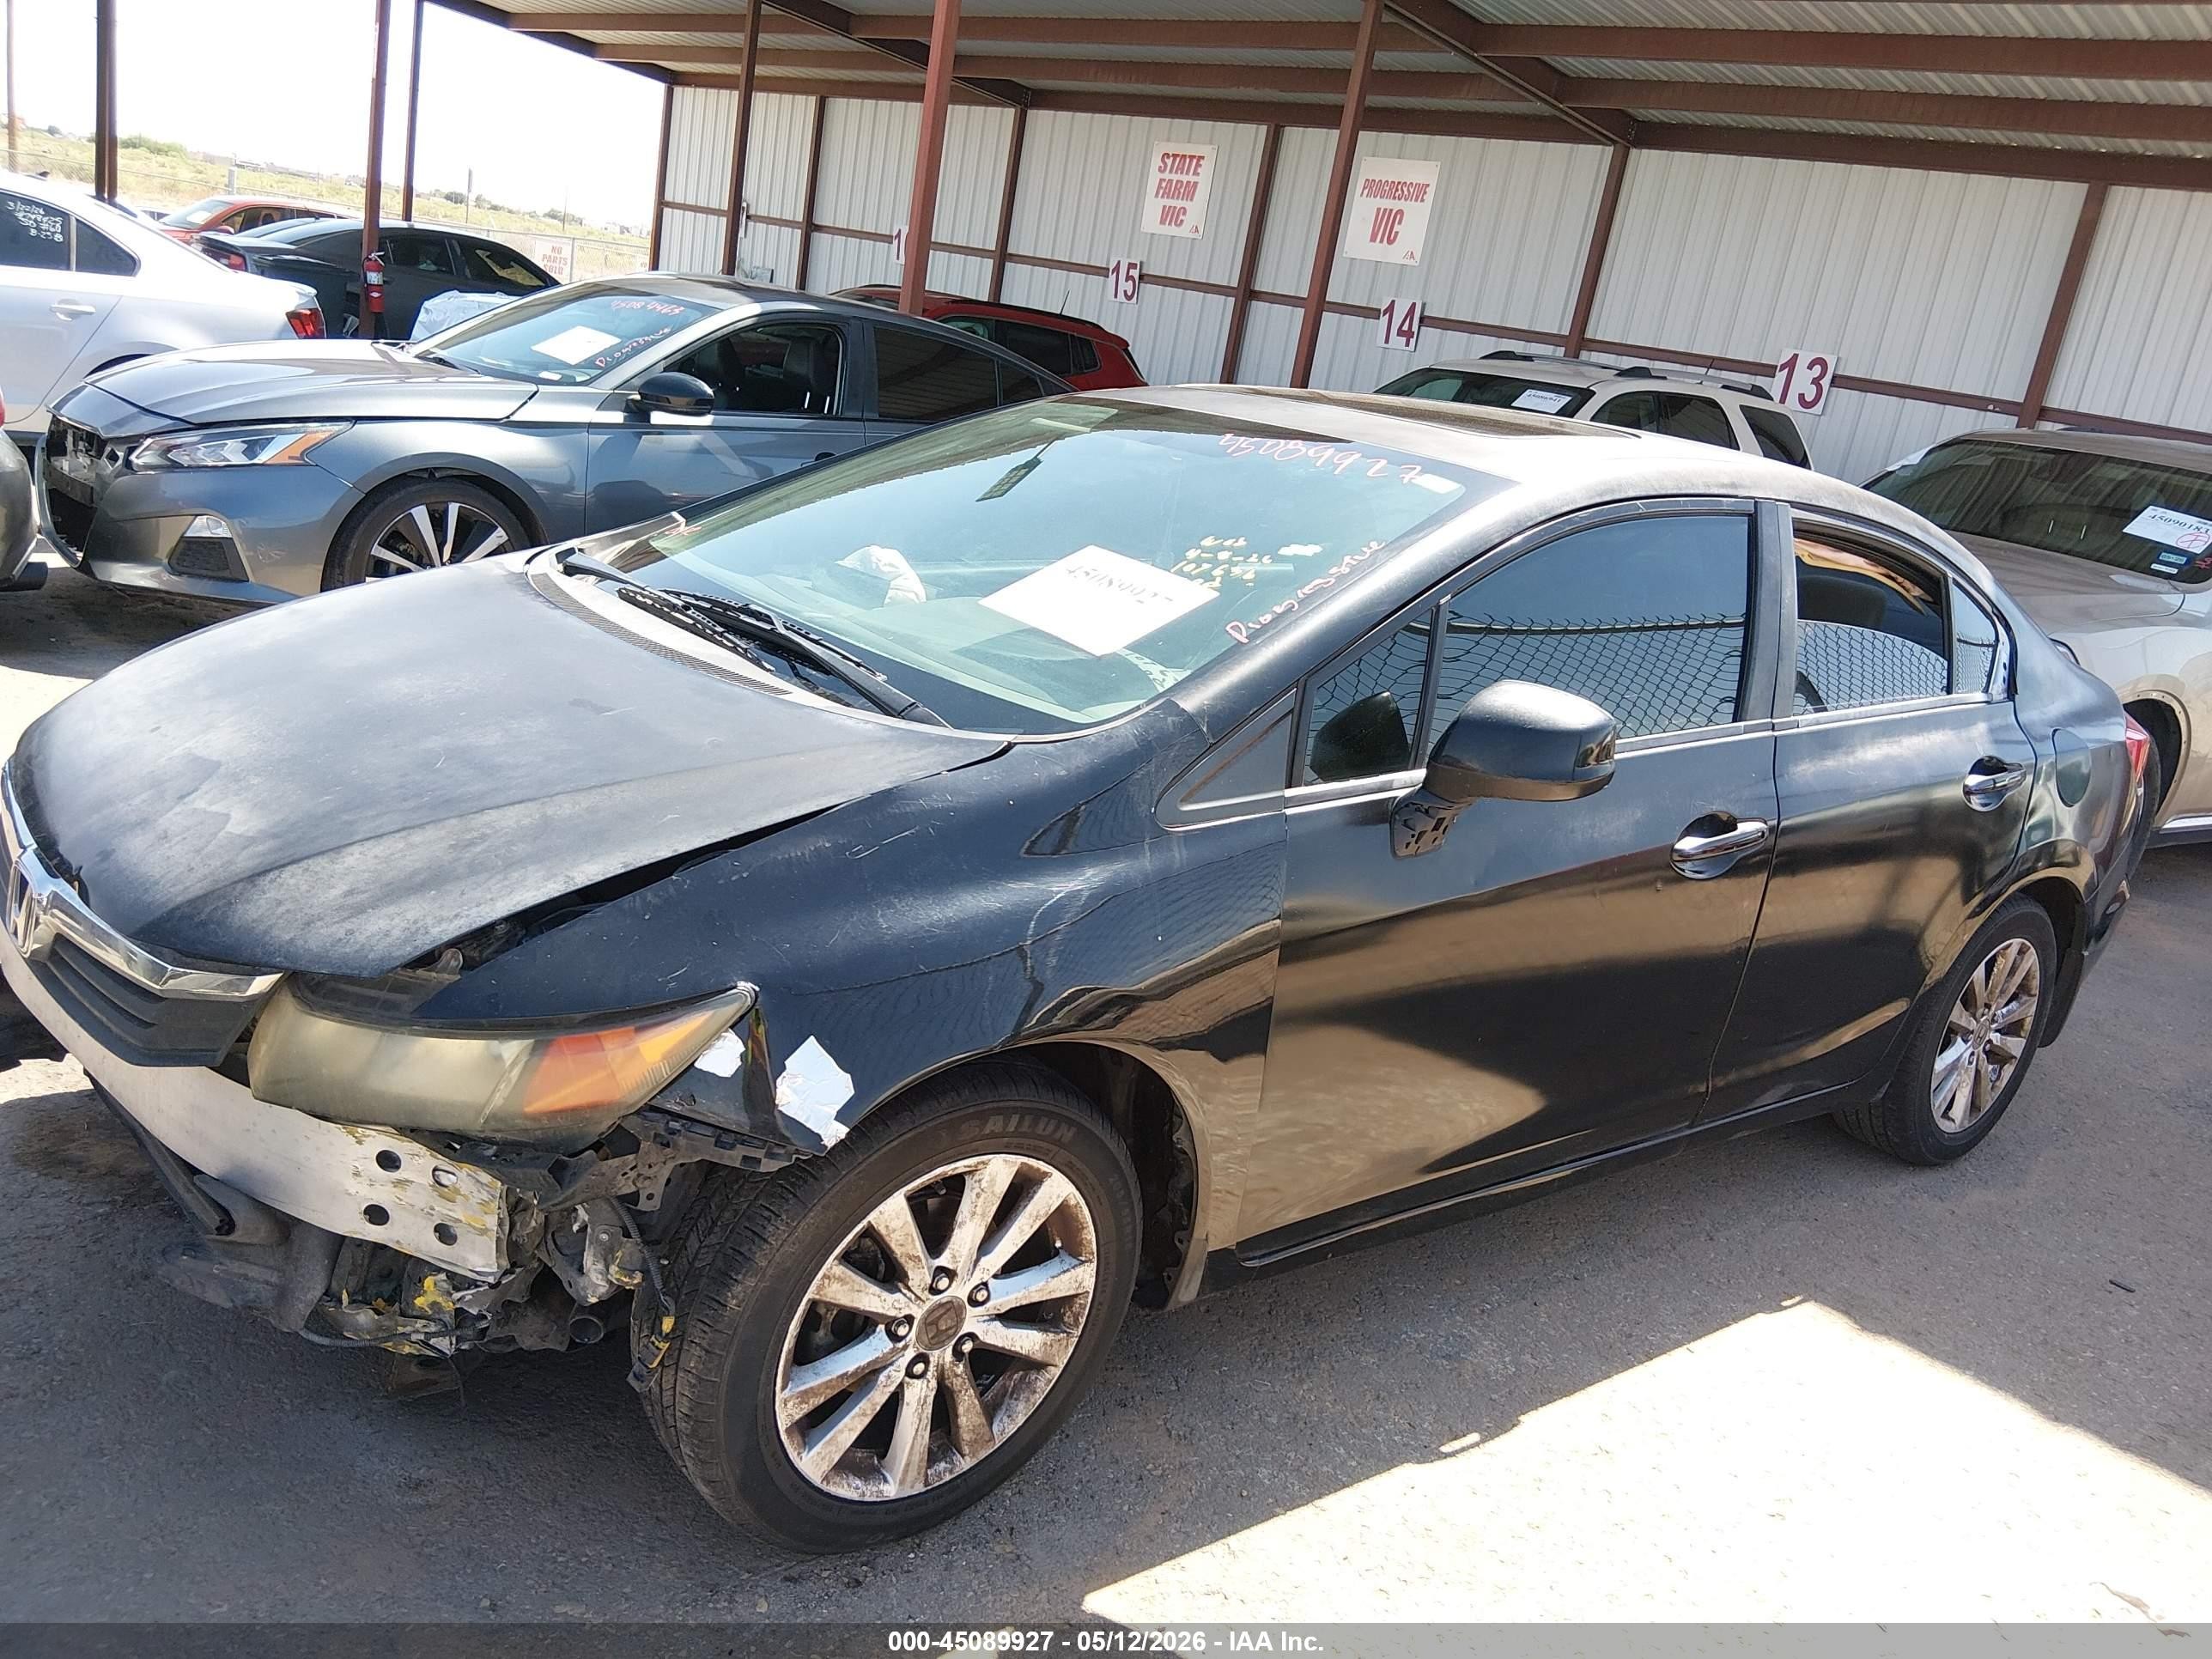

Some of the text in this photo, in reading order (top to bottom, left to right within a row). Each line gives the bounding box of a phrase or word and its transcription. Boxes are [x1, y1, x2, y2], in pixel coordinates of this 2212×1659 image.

[1158, 152, 1206, 177] STATE
[1154, 178, 1199, 203] FARM
[1359, 178, 1431, 203] PROGRESSIVE
[1159, 204, 1188, 228] VIC
[1369, 207, 1405, 246] VIC
[542, 253, 568, 266] PARTS
[550, 245, 563, 255] NO
[1111, 260, 1138, 301] 15
[1382, 299, 1417, 348] 14
[1778, 353, 1829, 410] 13
